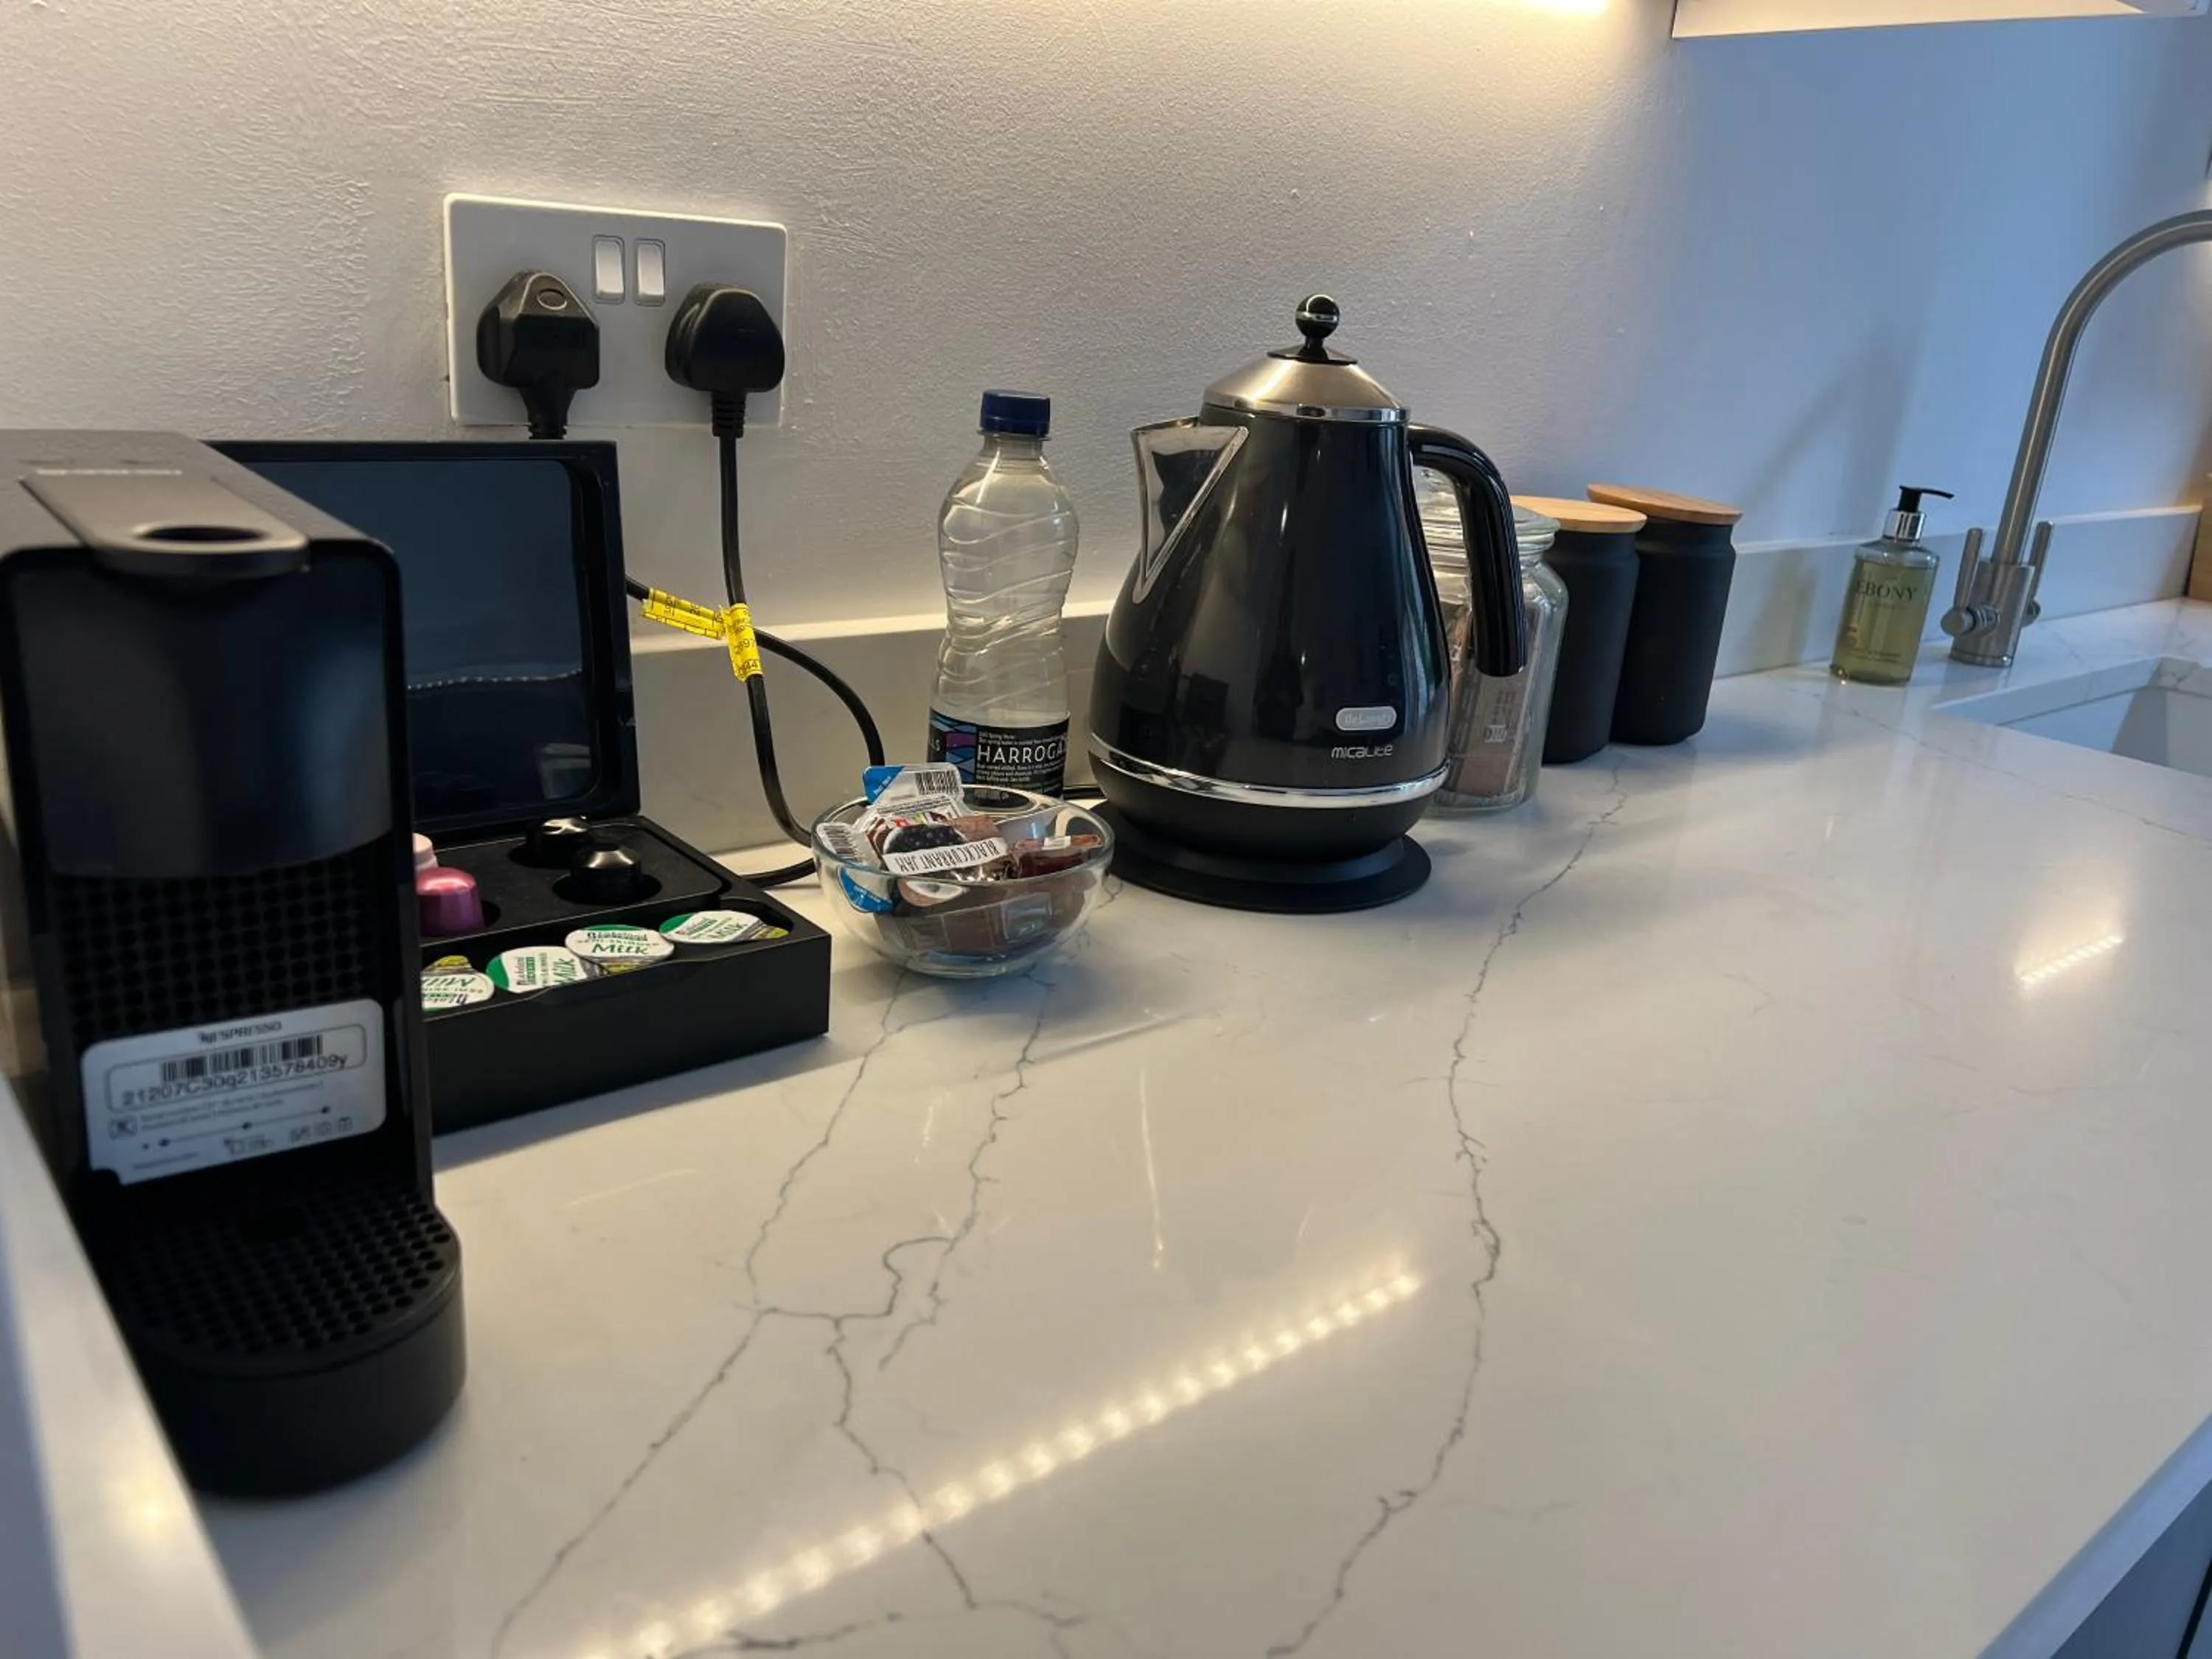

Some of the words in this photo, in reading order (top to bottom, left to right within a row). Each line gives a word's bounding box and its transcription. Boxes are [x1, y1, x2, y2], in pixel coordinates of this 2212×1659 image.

[1856, 577, 1918, 602] EBONY
[894, 855, 919, 873] JAM
[919, 840, 1001, 869] BLACKCURRANT
